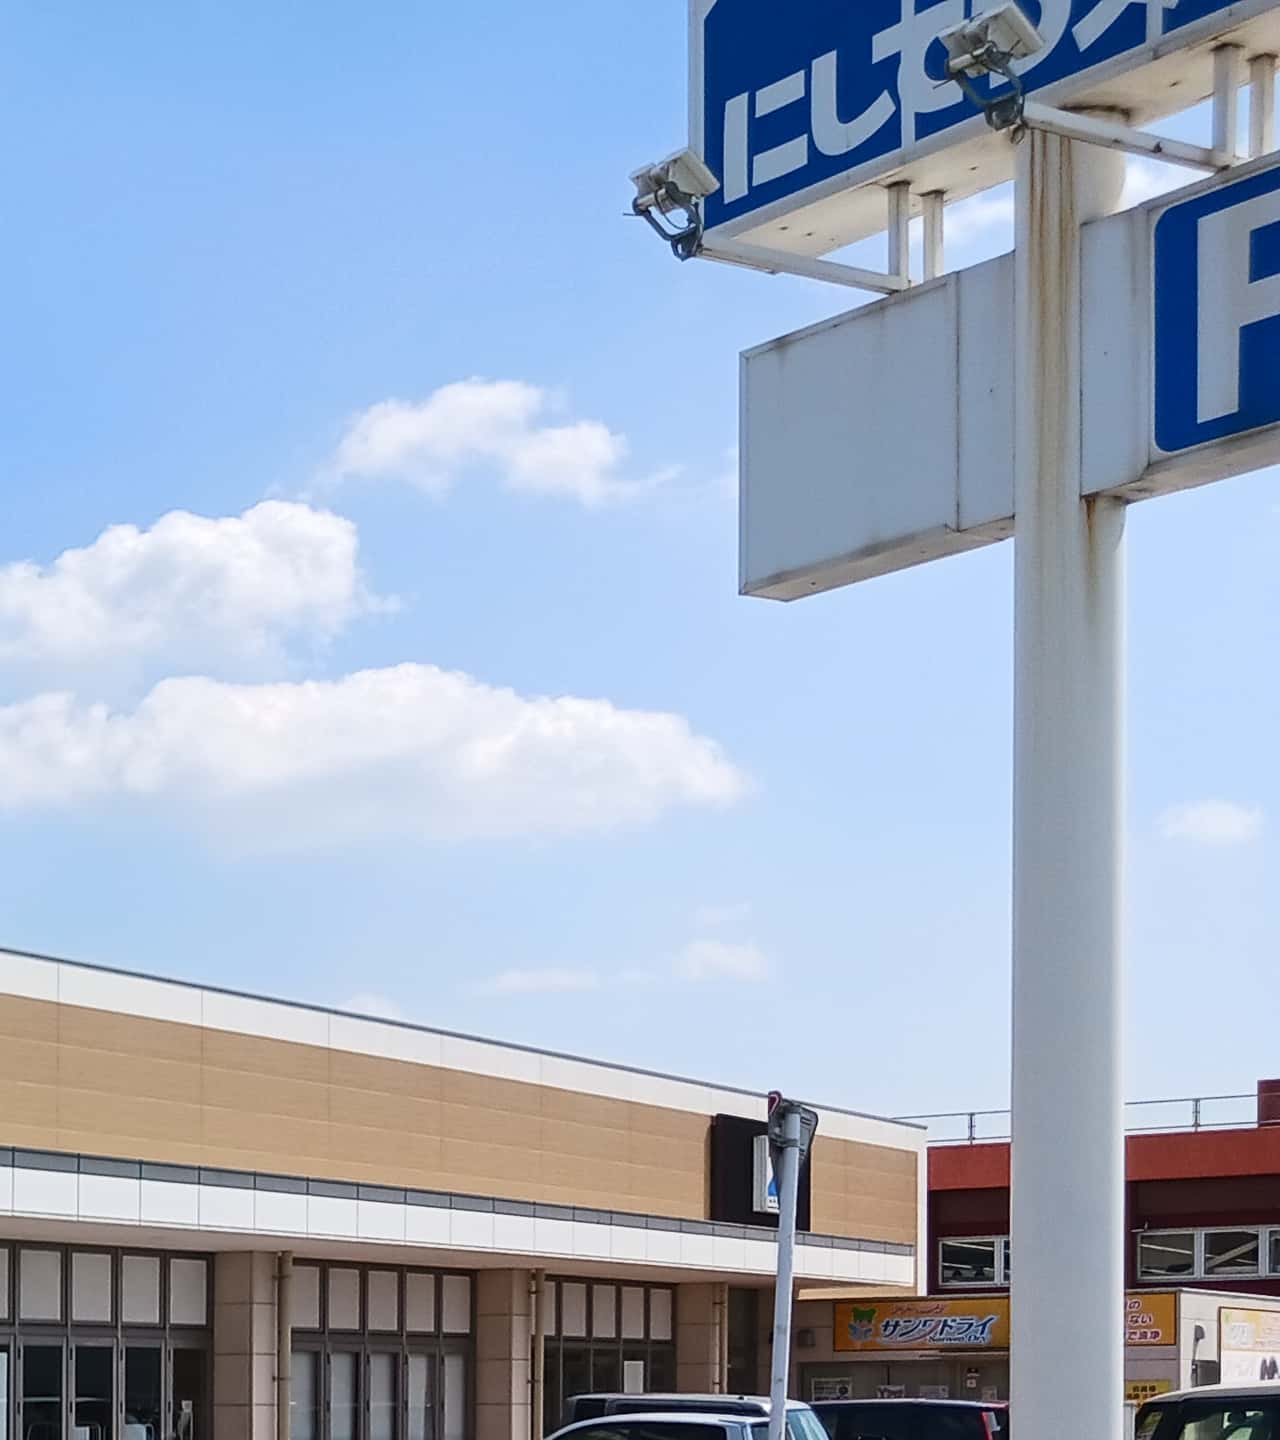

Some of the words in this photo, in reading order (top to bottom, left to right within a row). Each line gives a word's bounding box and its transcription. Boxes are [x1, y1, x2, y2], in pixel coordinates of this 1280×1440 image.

[881, 1316, 996, 1341] サンワドライ
